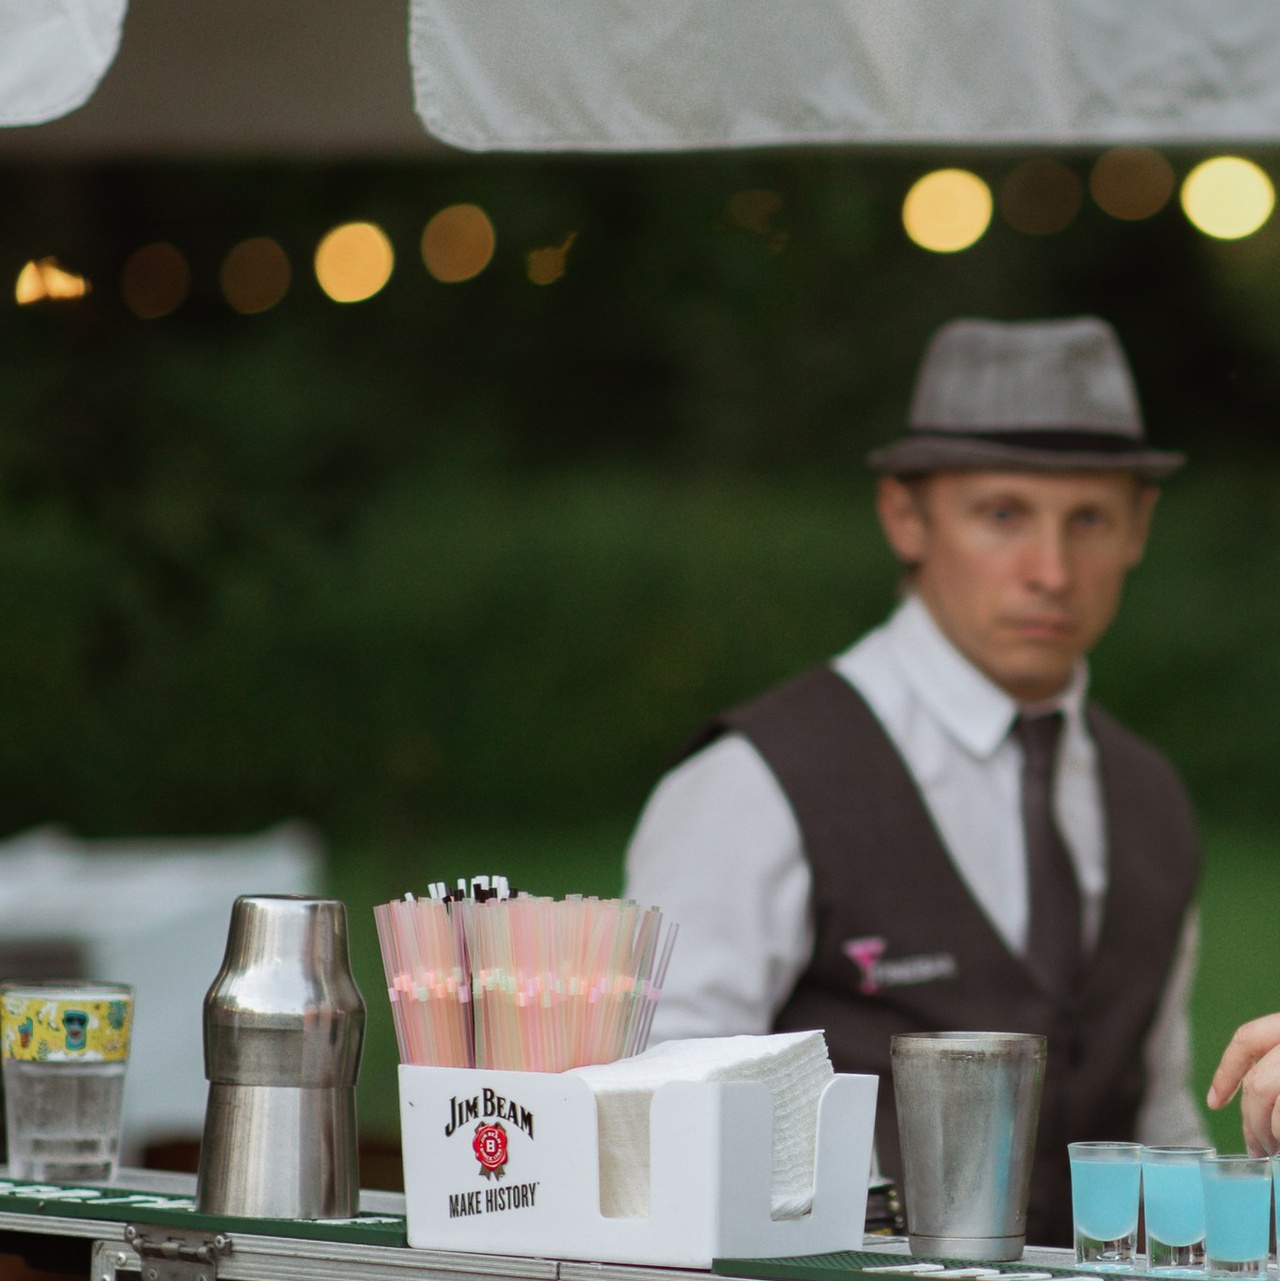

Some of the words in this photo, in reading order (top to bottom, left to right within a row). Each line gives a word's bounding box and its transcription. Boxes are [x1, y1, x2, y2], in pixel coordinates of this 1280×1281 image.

[445, 1095, 479, 1138] JIM
[482, 1087, 534, 1140] BEAM
[449, 1191, 482, 1219] MAKE
[485, 1182, 537, 1213] HISTORY
